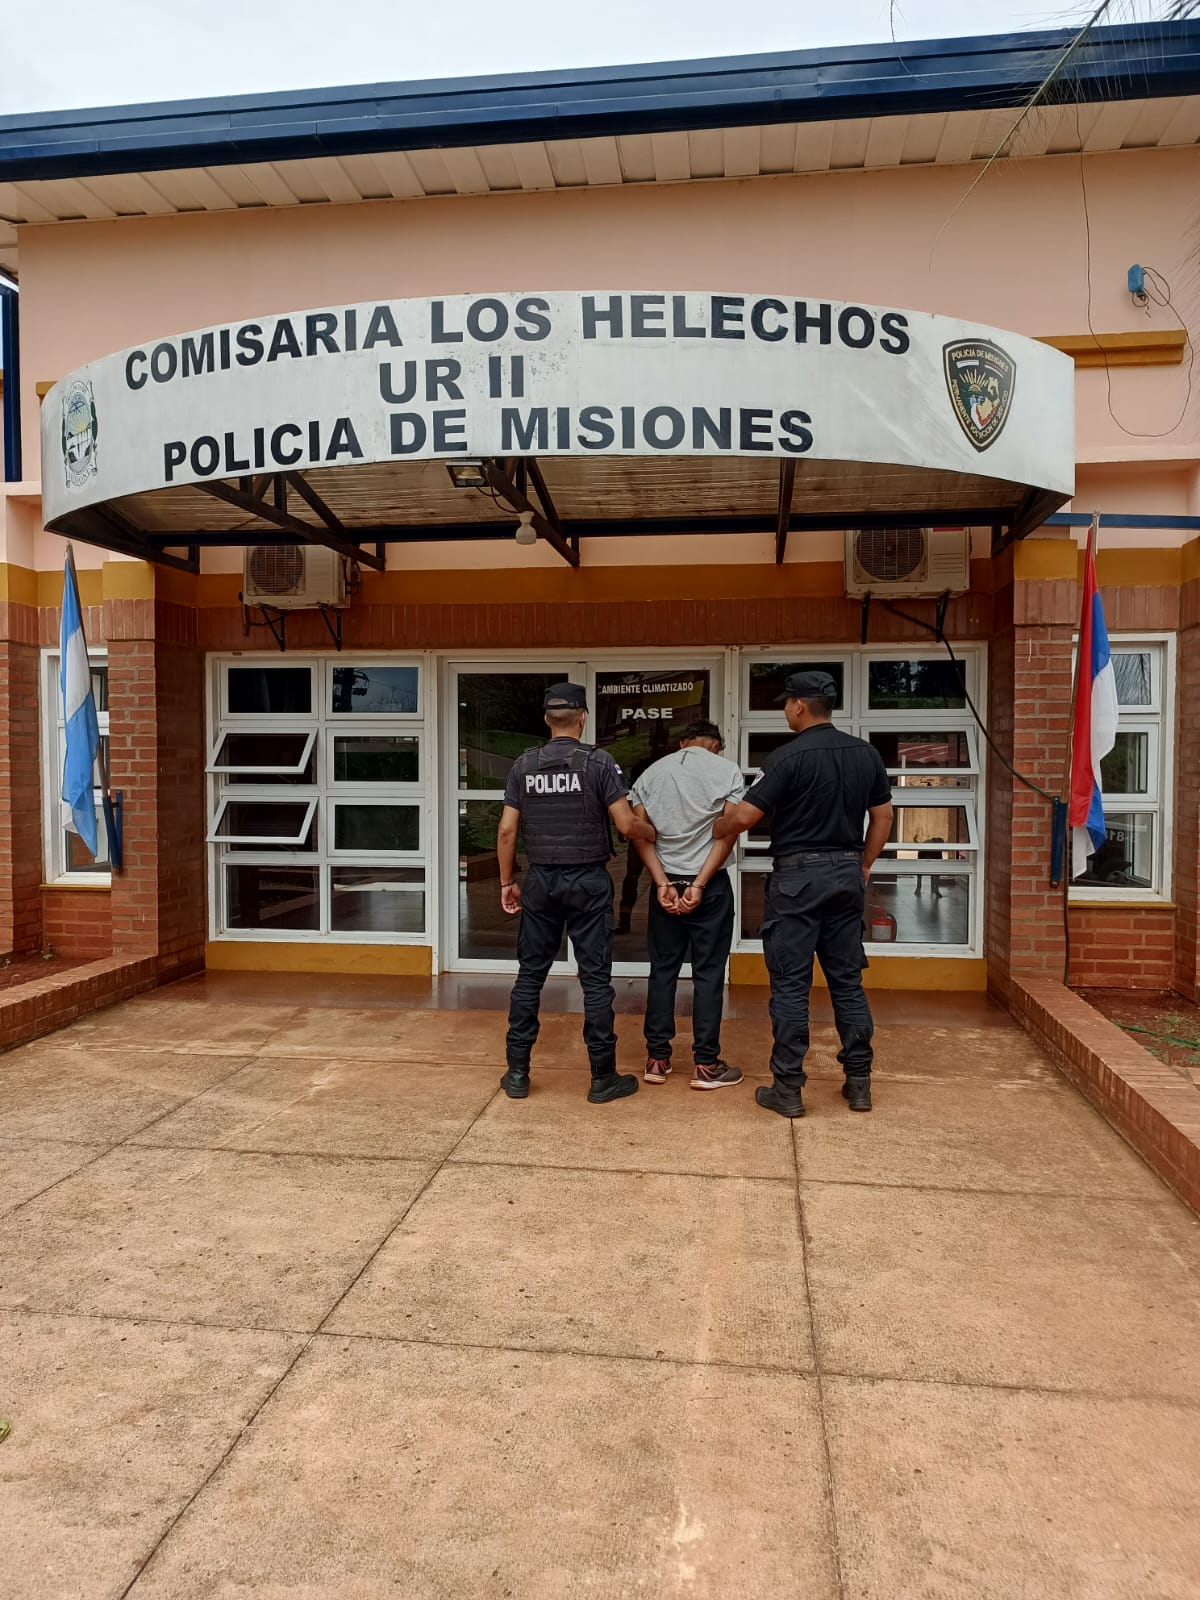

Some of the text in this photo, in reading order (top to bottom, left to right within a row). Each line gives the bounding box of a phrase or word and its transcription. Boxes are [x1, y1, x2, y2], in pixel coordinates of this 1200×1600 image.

[125, 295, 910, 391] COMISARIA LOS HELECHOS
[952, 349, 976, 360] POLICIA
[976, 349, 984, 358] DE
[379, 355, 524, 404] UR II
[163, 406, 814, 482] POLICIA DE MISIONES
[601, 682, 694, 695] AMBIENTE CLIMATIZADO
[621, 707, 673, 720] PASE
[525, 773, 582, 794] POLICIA
